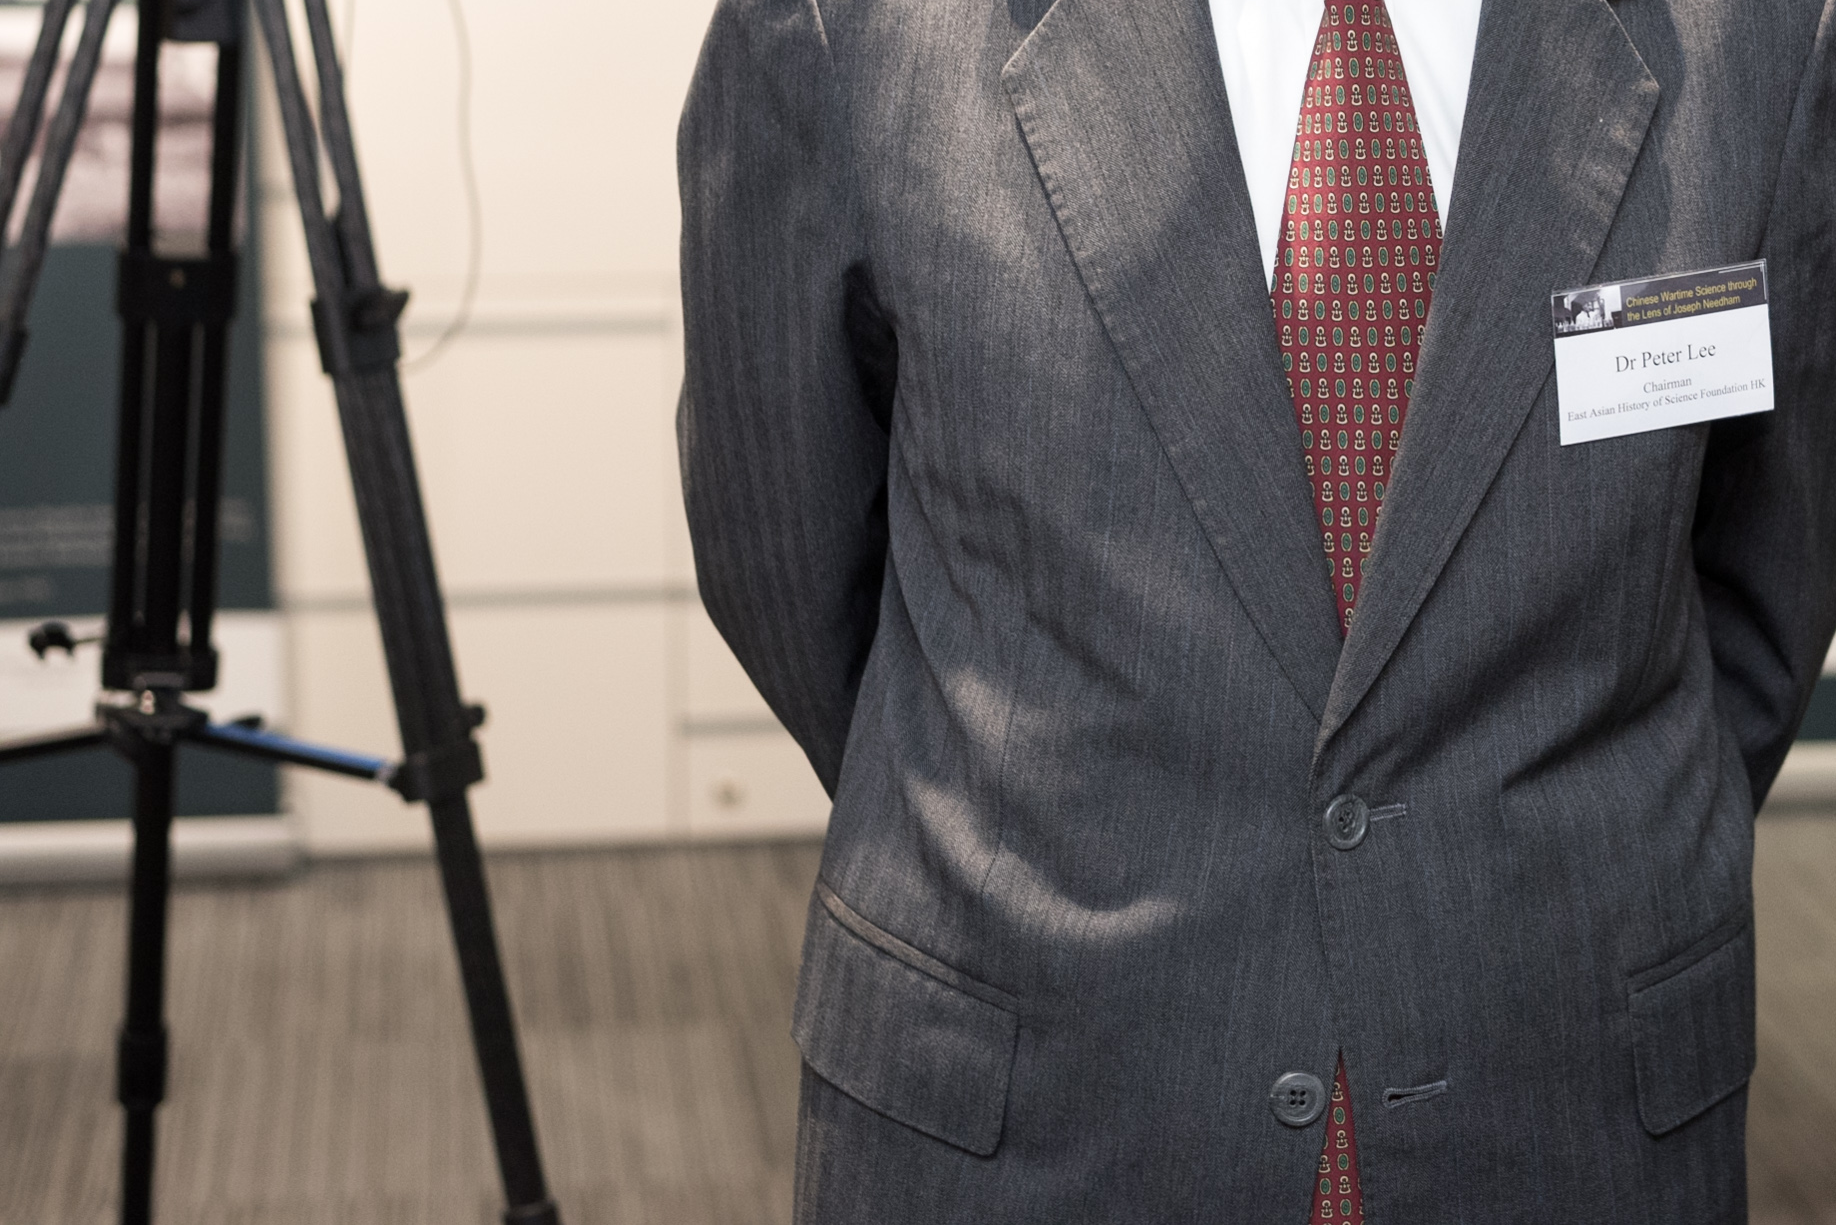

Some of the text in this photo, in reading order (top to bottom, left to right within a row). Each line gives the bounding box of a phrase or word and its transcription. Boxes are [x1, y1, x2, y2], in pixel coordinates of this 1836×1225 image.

[1626, 277, 1757, 308] Chinese Wartime Science through
[1626, 295, 1741, 321] the Lens of Joseph Needham
[1615, 344, 1716, 373] Dr Peter Lee
[1567, 378, 1766, 422] East Asian History of Science Foundation HK
[1643, 378, 1692, 394] Chairman
